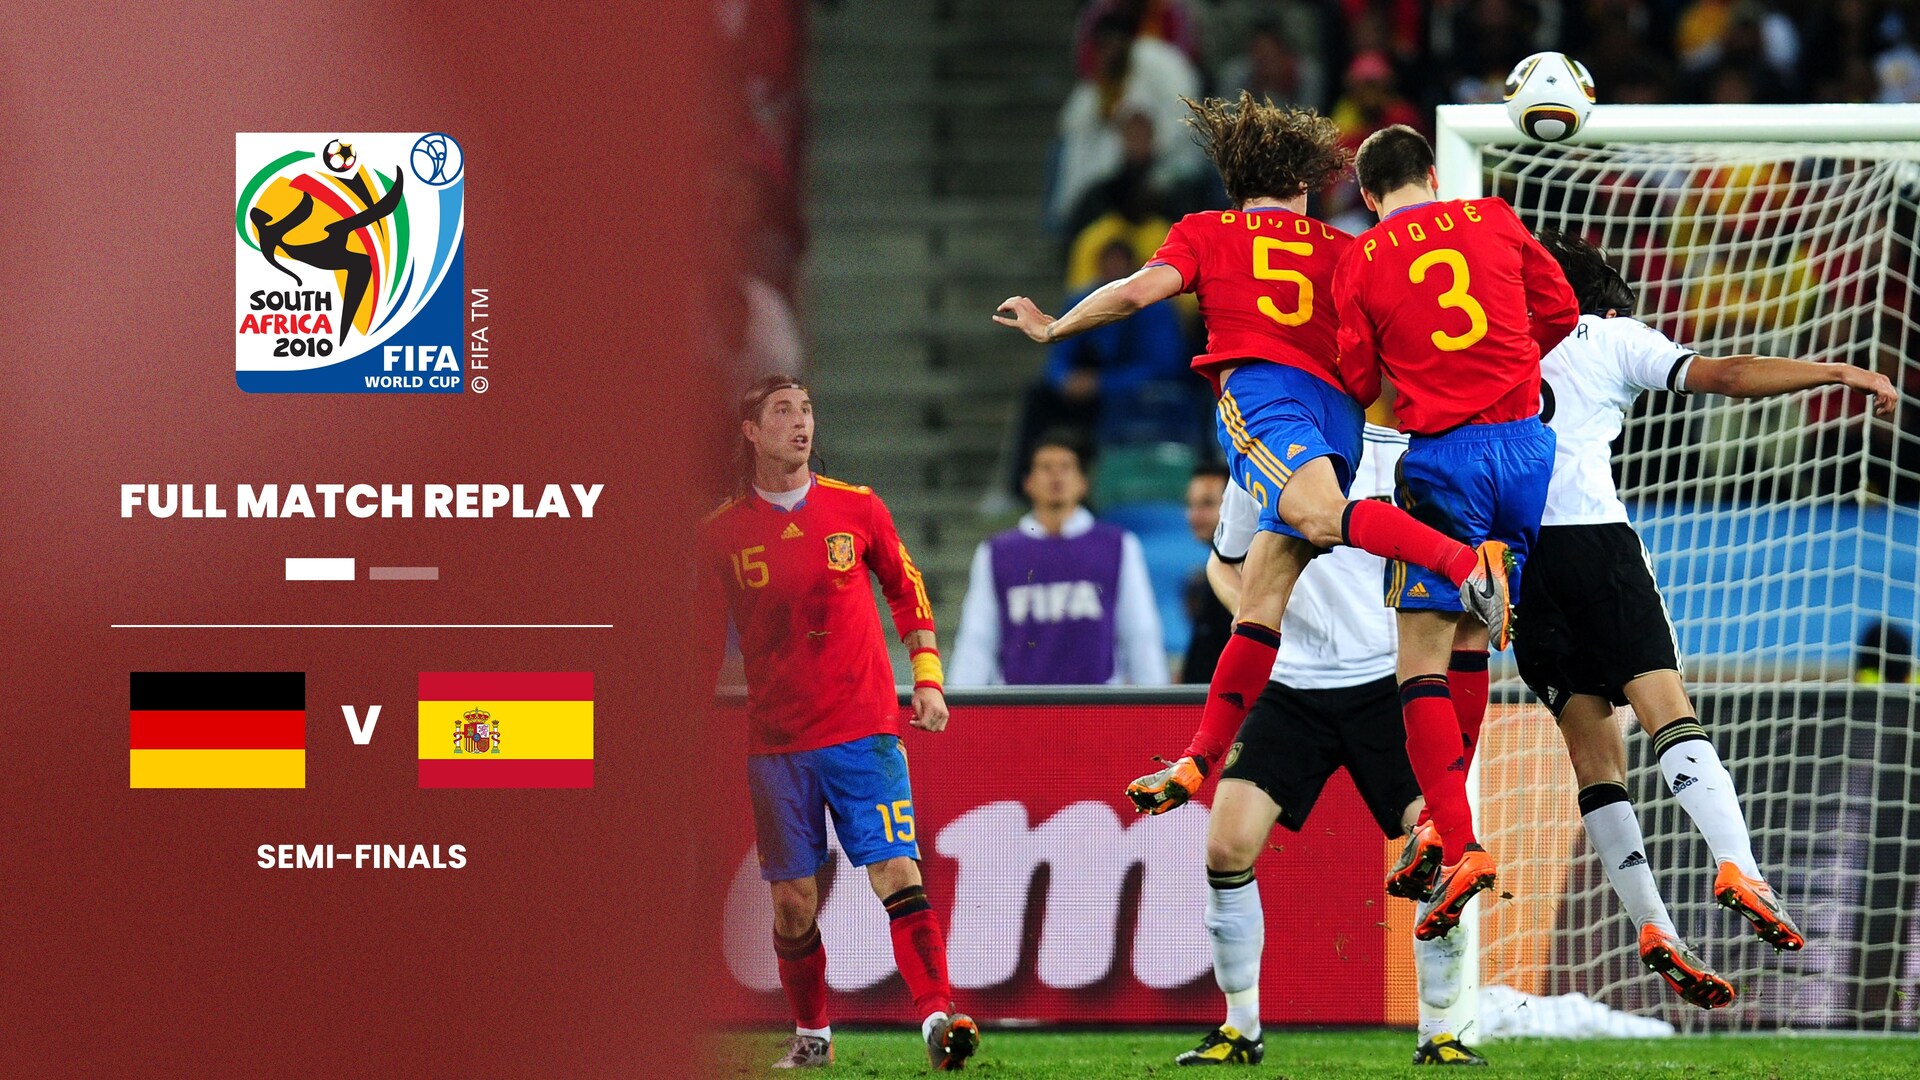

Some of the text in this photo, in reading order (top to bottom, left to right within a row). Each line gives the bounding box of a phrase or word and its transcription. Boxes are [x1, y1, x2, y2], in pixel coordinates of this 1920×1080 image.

[1363, 202, 1482, 262] PIQUÉ
[1252, 235, 1314, 327] 5
[1408, 248, 1488, 352] 3
[731, 545, 769, 590] 15
[1007, 581, 1103, 624] FIFA
[876, 800, 916, 843] 15
